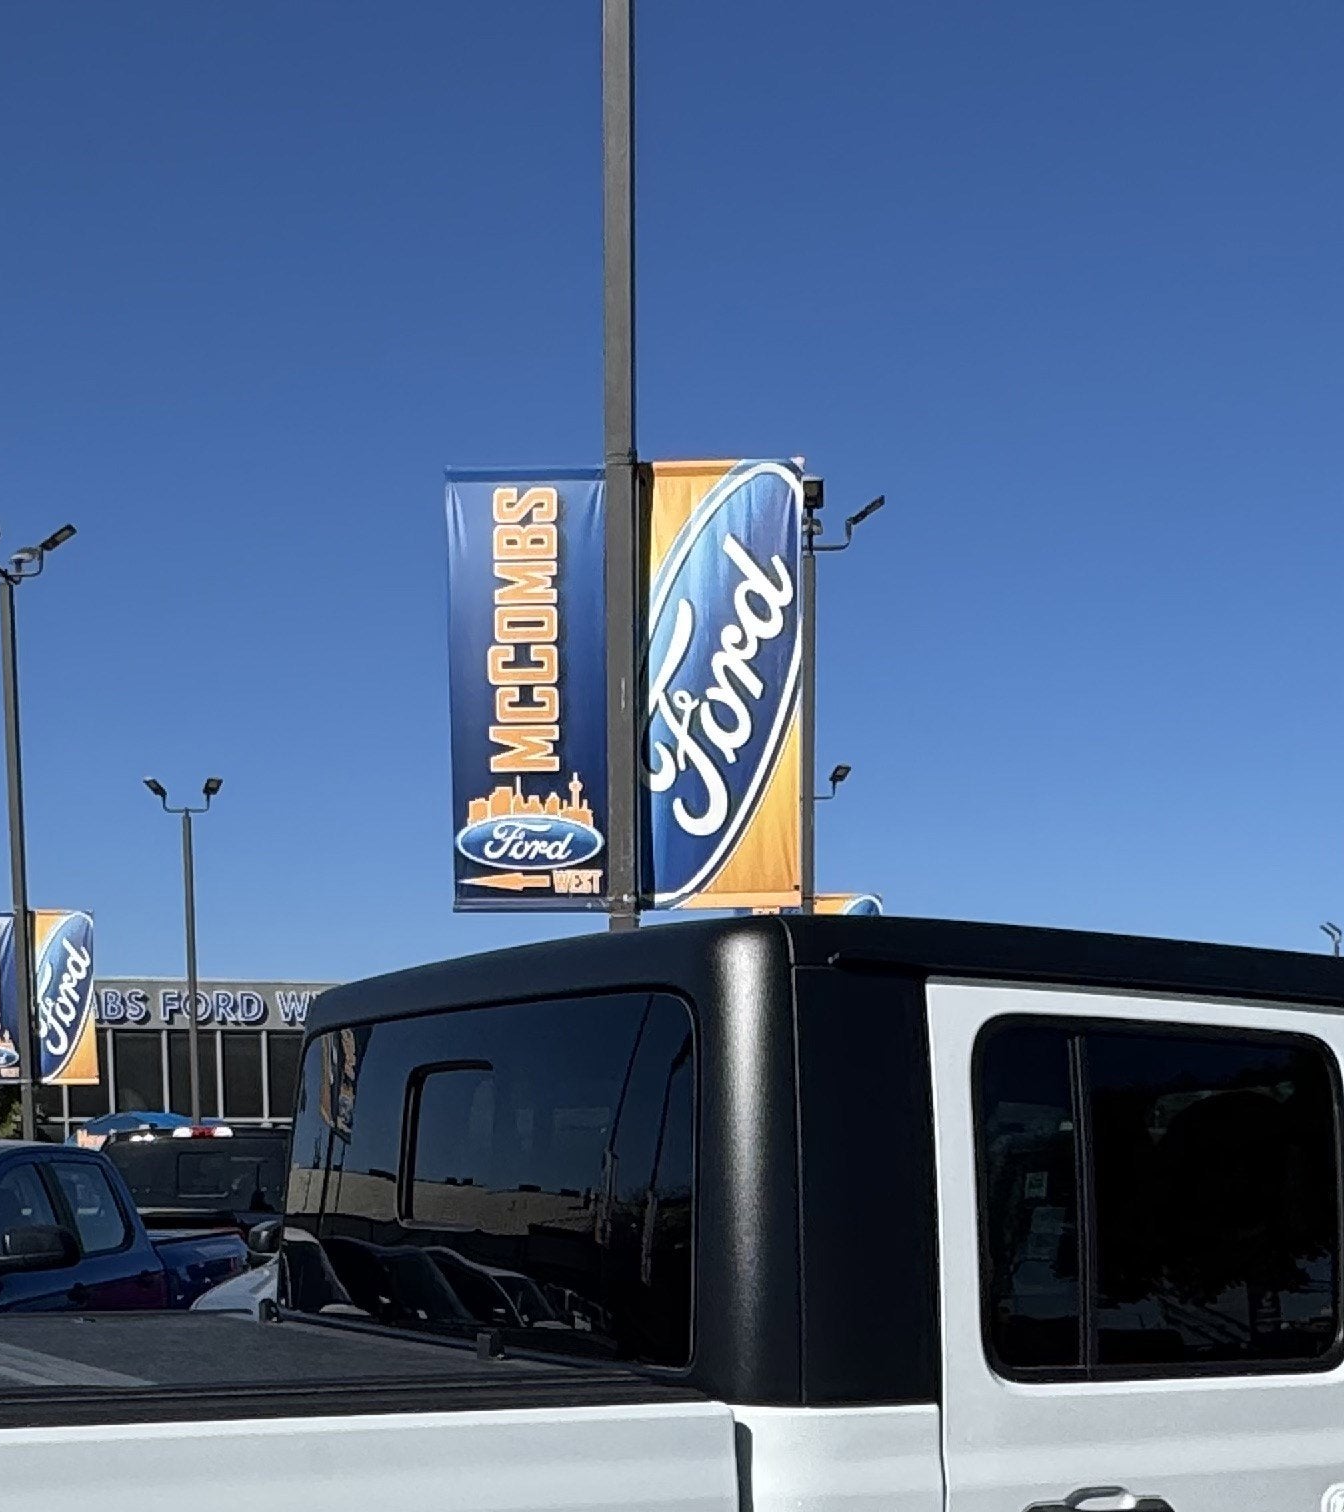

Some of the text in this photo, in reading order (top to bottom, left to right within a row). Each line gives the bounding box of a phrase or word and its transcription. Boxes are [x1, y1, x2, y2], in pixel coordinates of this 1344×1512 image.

[643, 533, 794, 837] Ford
[483, 822, 574, 860] Ford
[552, 869, 603, 894] WEST
[39, 937, 91, 1056] Ford
[93, 988, 320, 1022] BS FORD W
